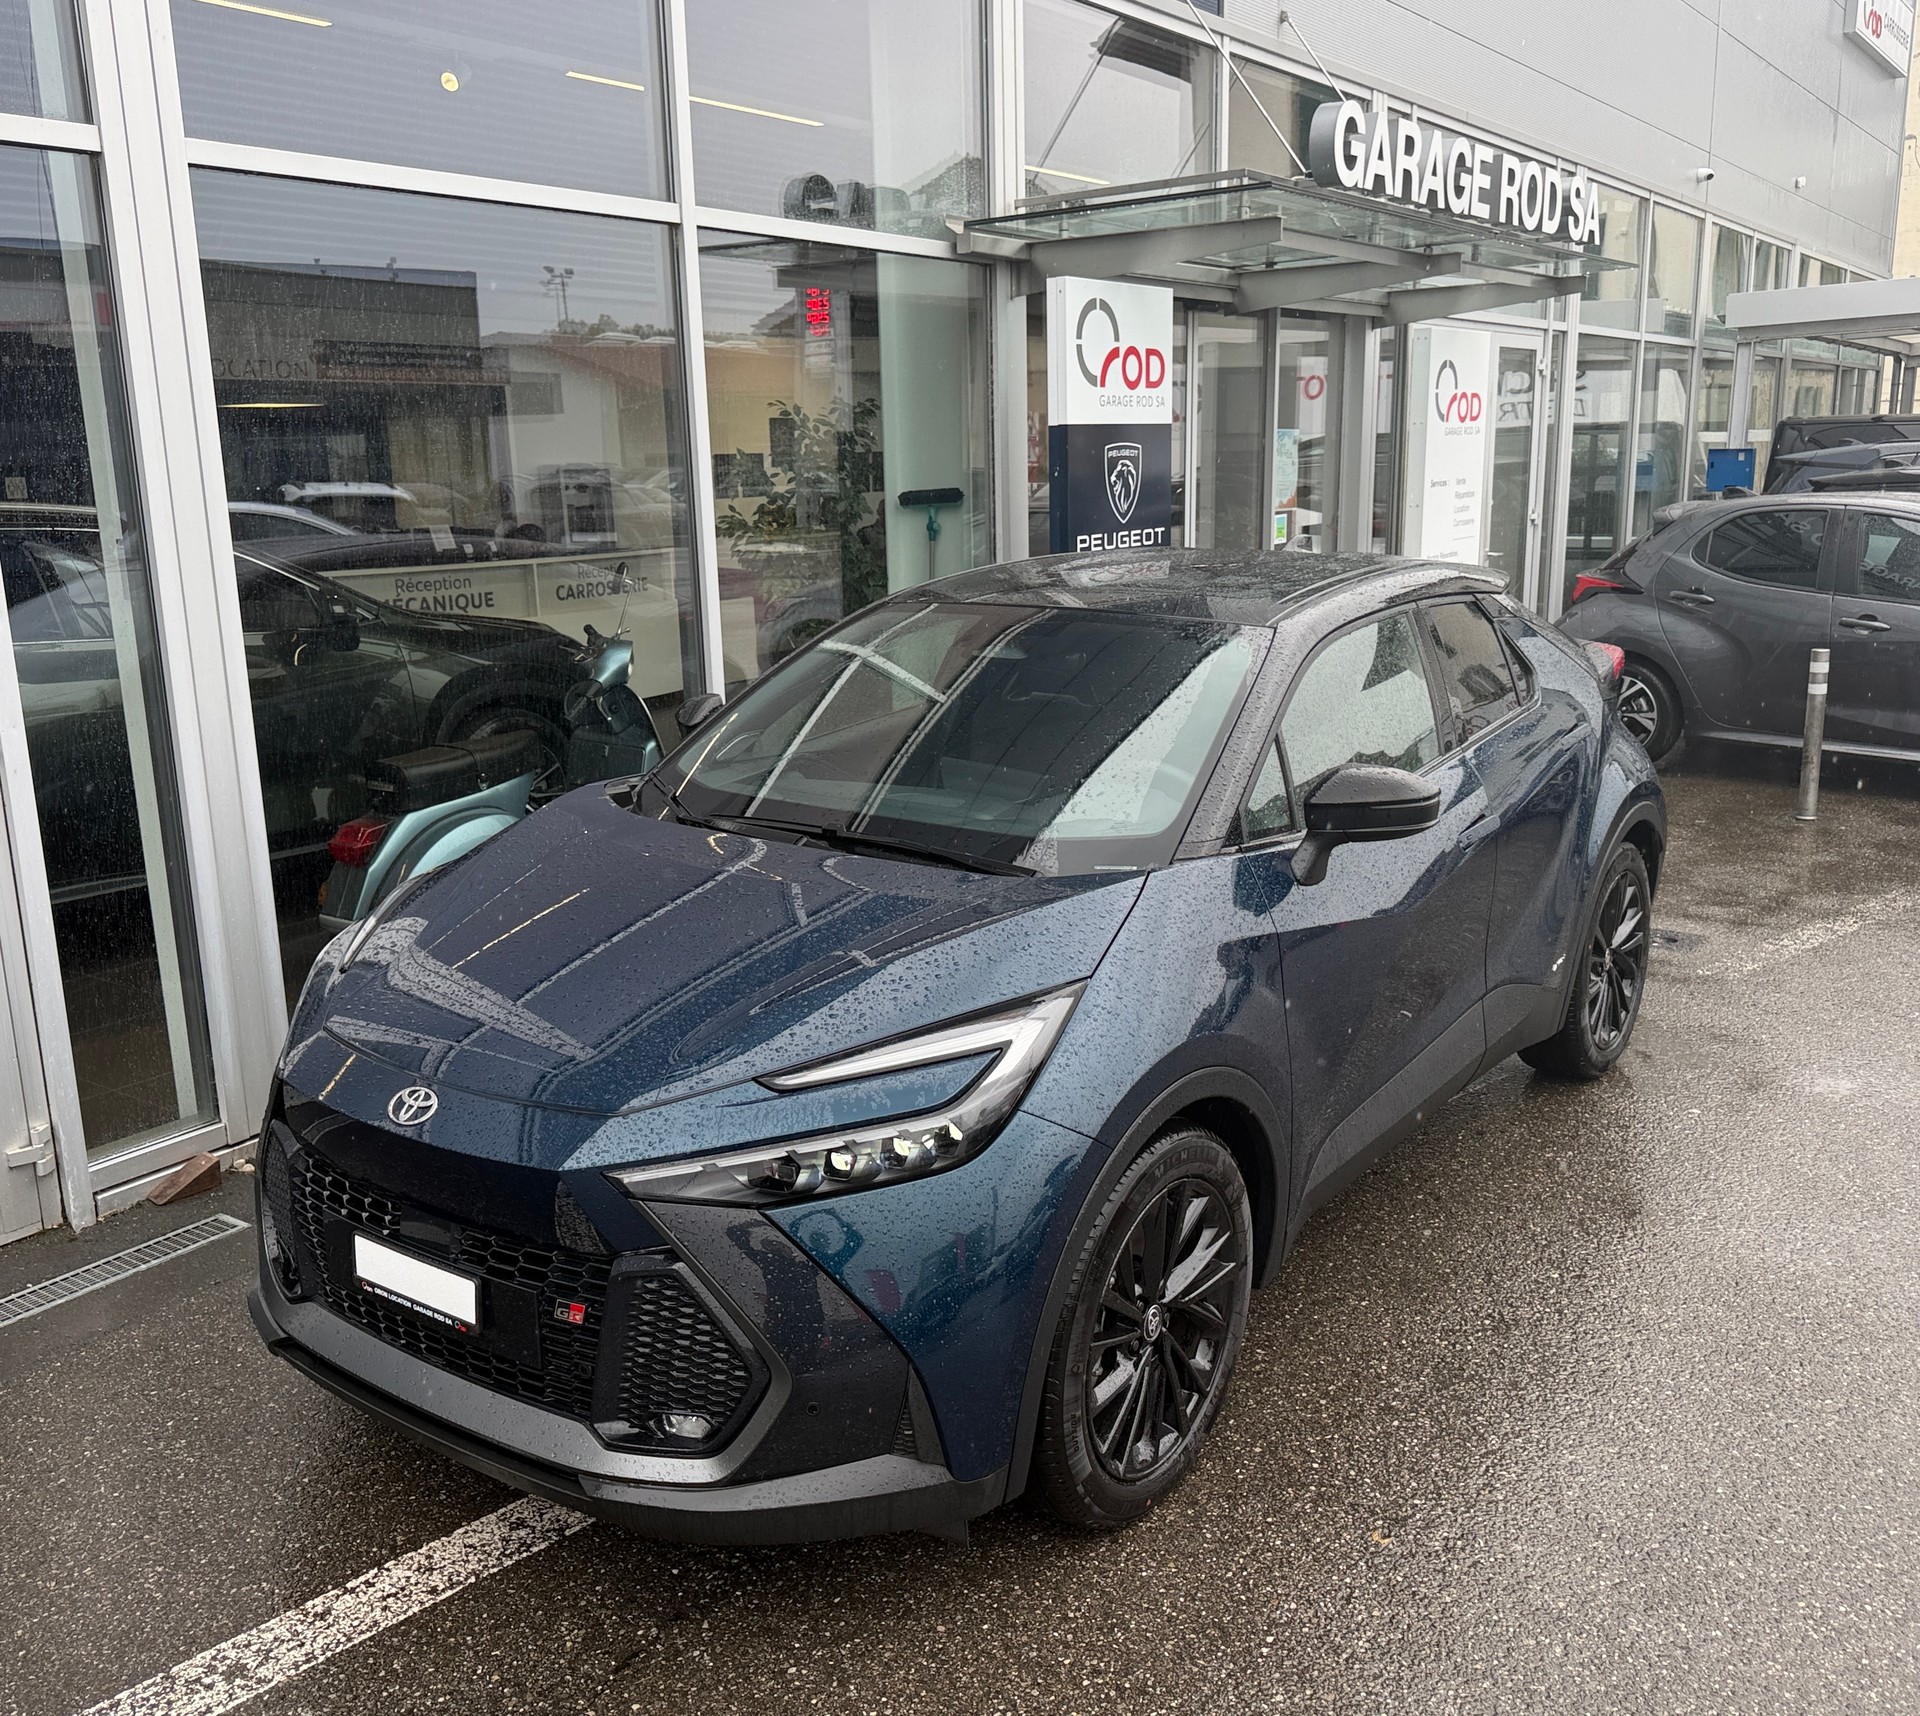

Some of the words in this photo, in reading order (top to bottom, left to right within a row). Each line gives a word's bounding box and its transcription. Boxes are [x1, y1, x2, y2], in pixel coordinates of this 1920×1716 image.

[1334, 99, 1495, 220] GARAGE
[1499, 153, 1563, 235] ROD
[1568, 175, 1601, 246] SA
[1099, 394, 1134, 408] GARAGE
[1136, 395, 1154, 408] ROD
[1155, 395, 1166, 408] SA
[1444, 426, 1463, 437] GARAGE
[1464, 426, 1474, 436] ROD
[1107, 449, 1139, 459] PEUGEOT
[1076, 527, 1166, 553] PEUGEOT
[395, 575, 472, 595] Réception
[555, 577, 649, 601] CARROSERIE
[383, 591, 495, 613] ÉCANIQUE
[388, 1293, 412, 1308] LOCATION
[413, 1304, 433, 1317] GARAGE
[433, 1312, 445, 1323] ROD
[445, 1317, 453, 1326] SA
[556, 1307, 582, 1321] GR
[1070, 1413, 1080, 1453] OUTSIDE
